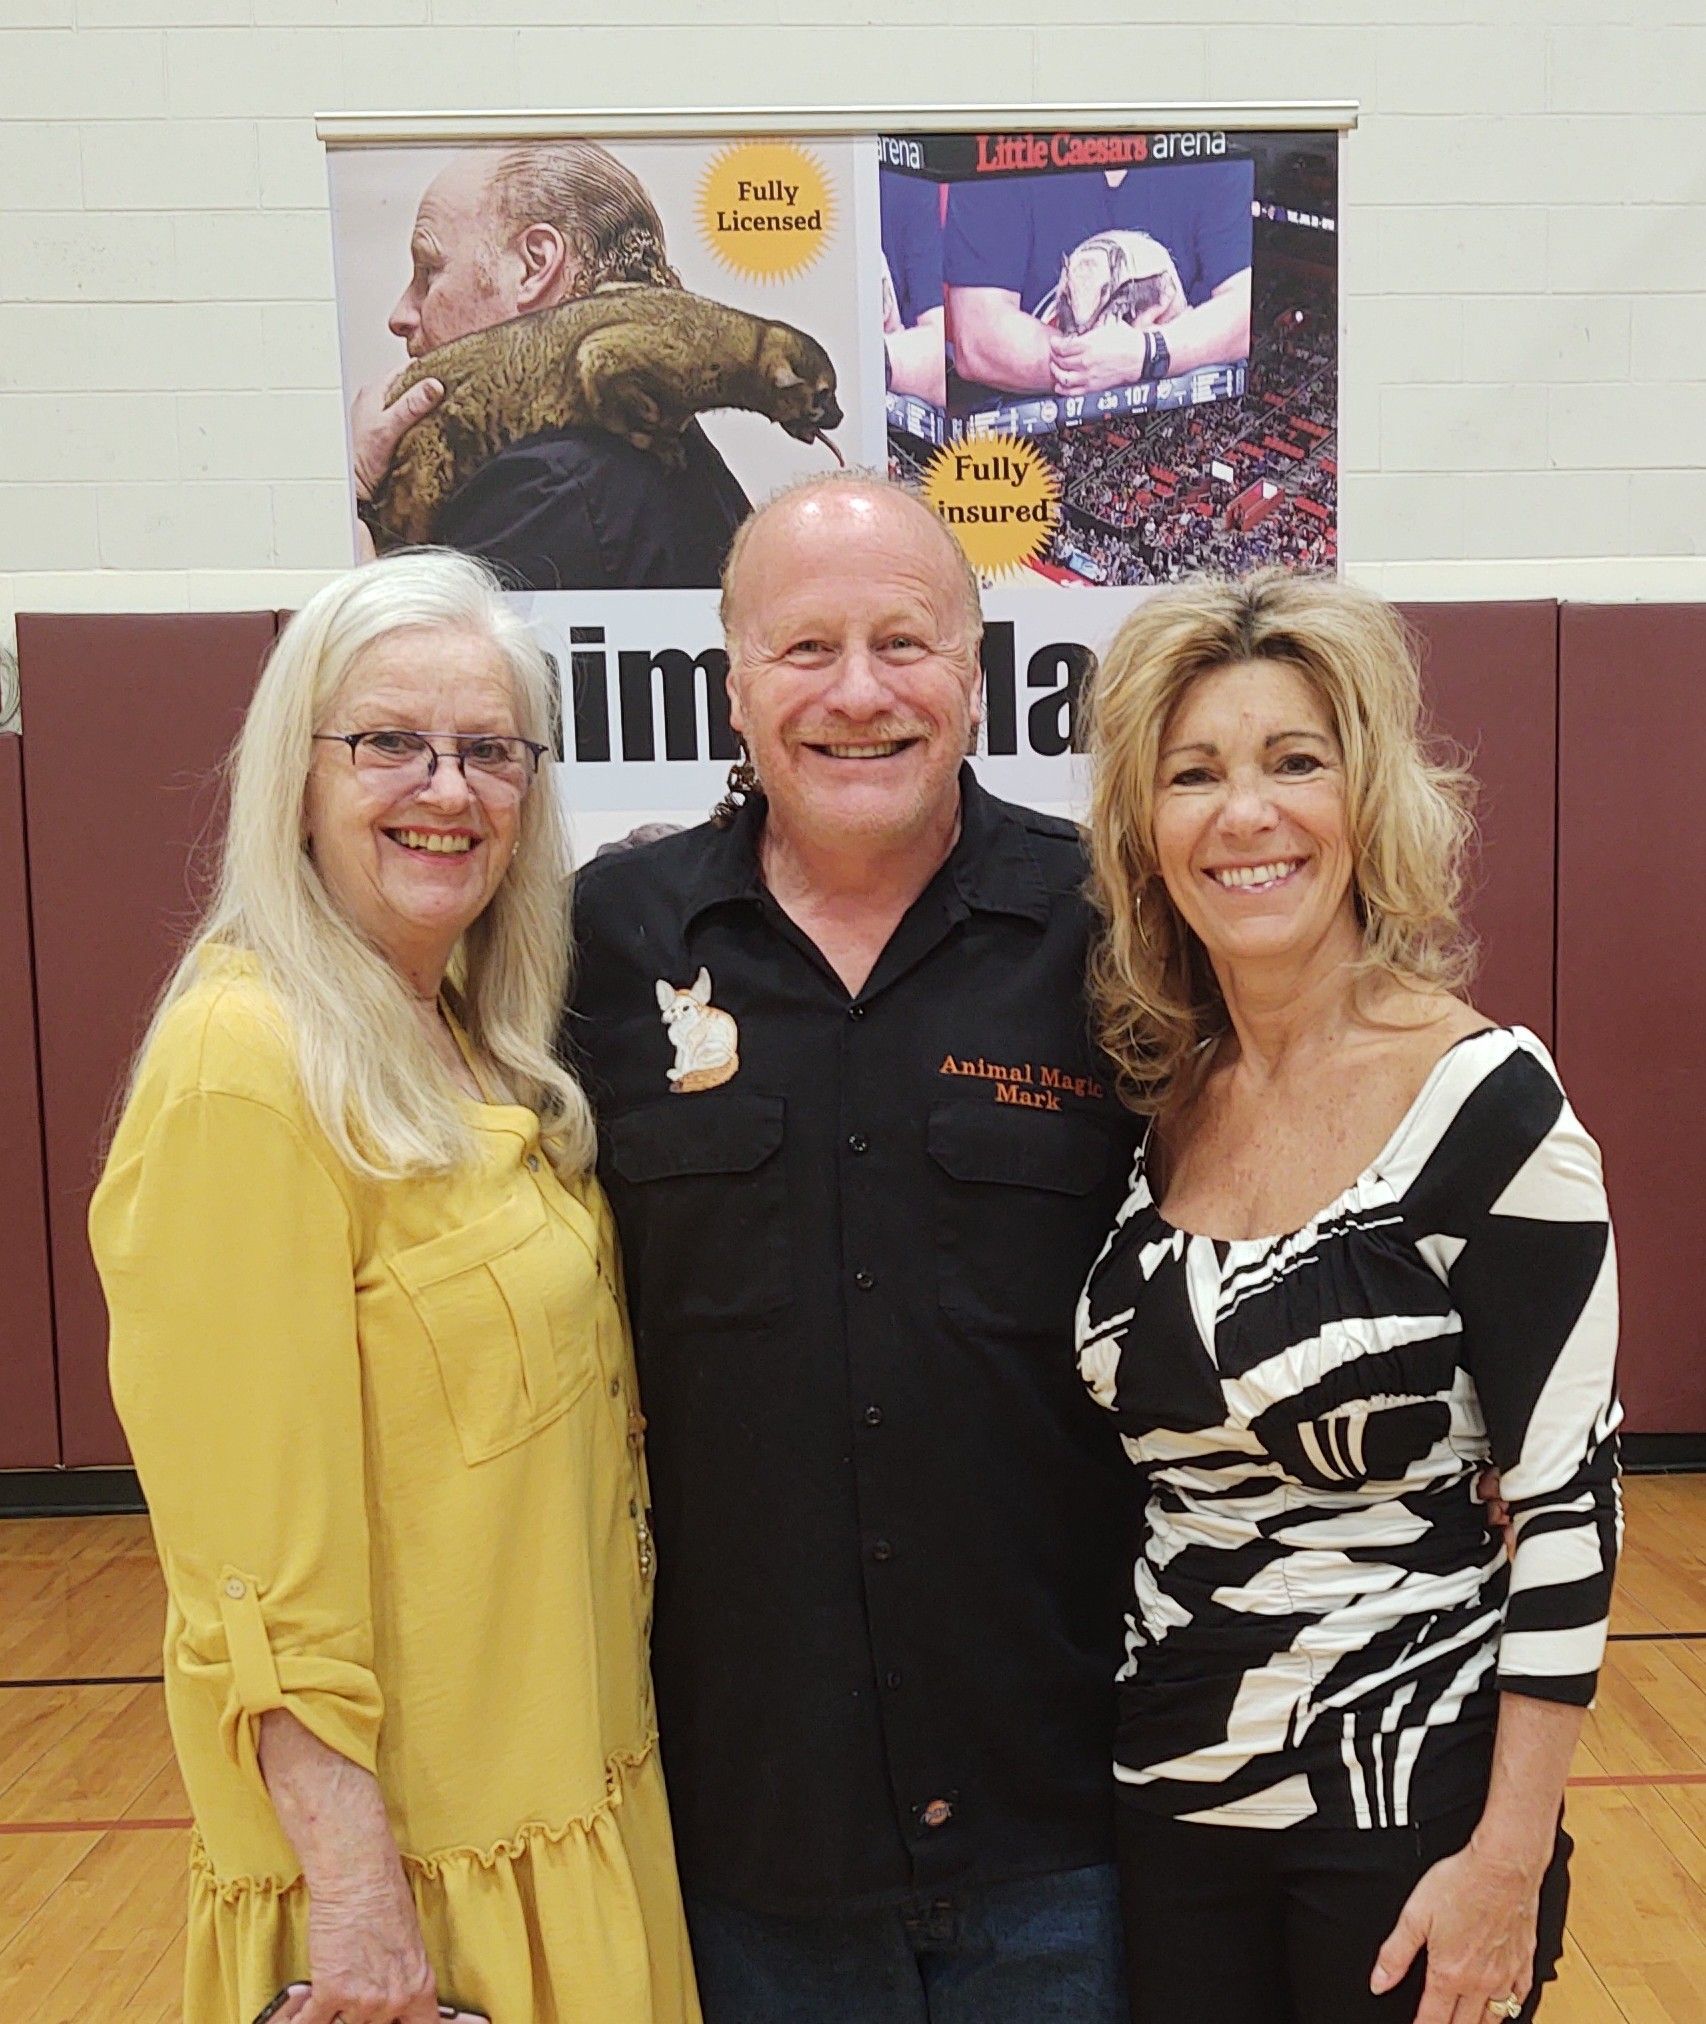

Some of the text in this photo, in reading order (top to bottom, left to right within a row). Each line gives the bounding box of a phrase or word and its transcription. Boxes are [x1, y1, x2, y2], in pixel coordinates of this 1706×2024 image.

[976, 131, 1226, 173] Little Caesars arena
[738, 180, 799, 206] Fully
[717, 210, 822, 231] Licensed
[1066, 397, 1084, 417] 97
[1124, 386, 1149, 406] 107
[955, 454, 1030, 487] Fully
[938, 498, 1050, 523] insured
[939, 1055, 1103, 1097] Animal Magic
[994, 1082, 1063, 1111] Mark
